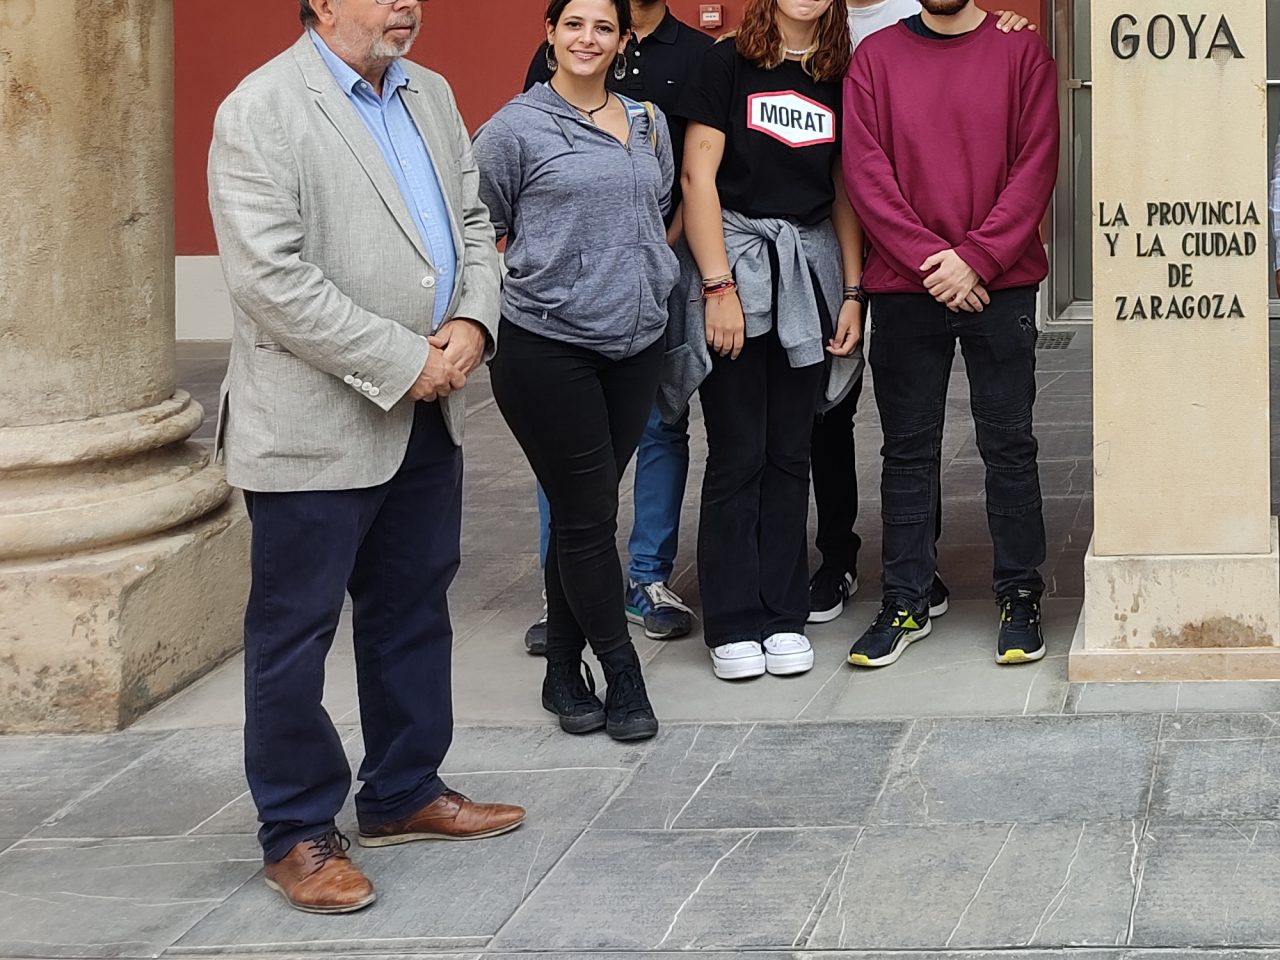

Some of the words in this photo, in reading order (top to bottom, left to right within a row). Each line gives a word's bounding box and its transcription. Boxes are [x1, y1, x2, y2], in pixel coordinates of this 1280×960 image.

[1110, 13, 1245, 60] GOYA
[760, 101, 826, 133] MORAT
[1099, 202, 1130, 227] LA
[1147, 200, 1261, 226] PROVINCIA
[1104, 232, 1119, 257] Y
[1136, 232, 1166, 258] LA
[1182, 231, 1257, 257] CIUDAD
[1167, 263, 1193, 288] DE
[1115, 294, 1245, 321] ZARAGOZA
